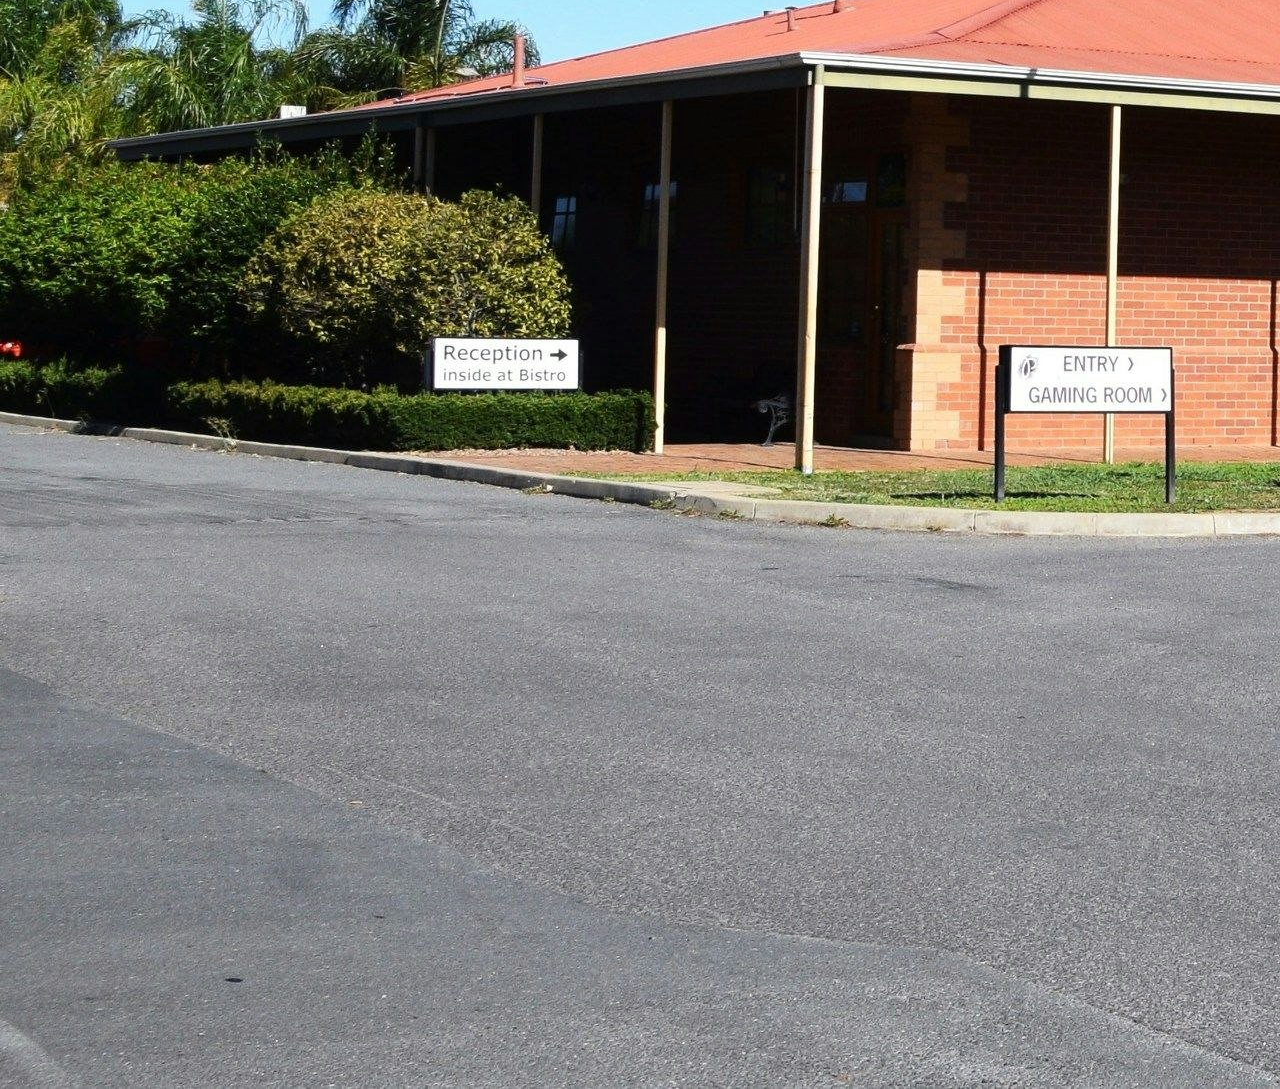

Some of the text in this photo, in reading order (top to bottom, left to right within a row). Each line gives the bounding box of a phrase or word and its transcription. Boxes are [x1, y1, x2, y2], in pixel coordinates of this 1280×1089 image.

[444, 345, 543, 364] Reception
[1063, 355, 1119, 372] ENTRY
[443, 368, 566, 381] inside at Bistro
[1028, 387, 1152, 403] GAMING ROOM
